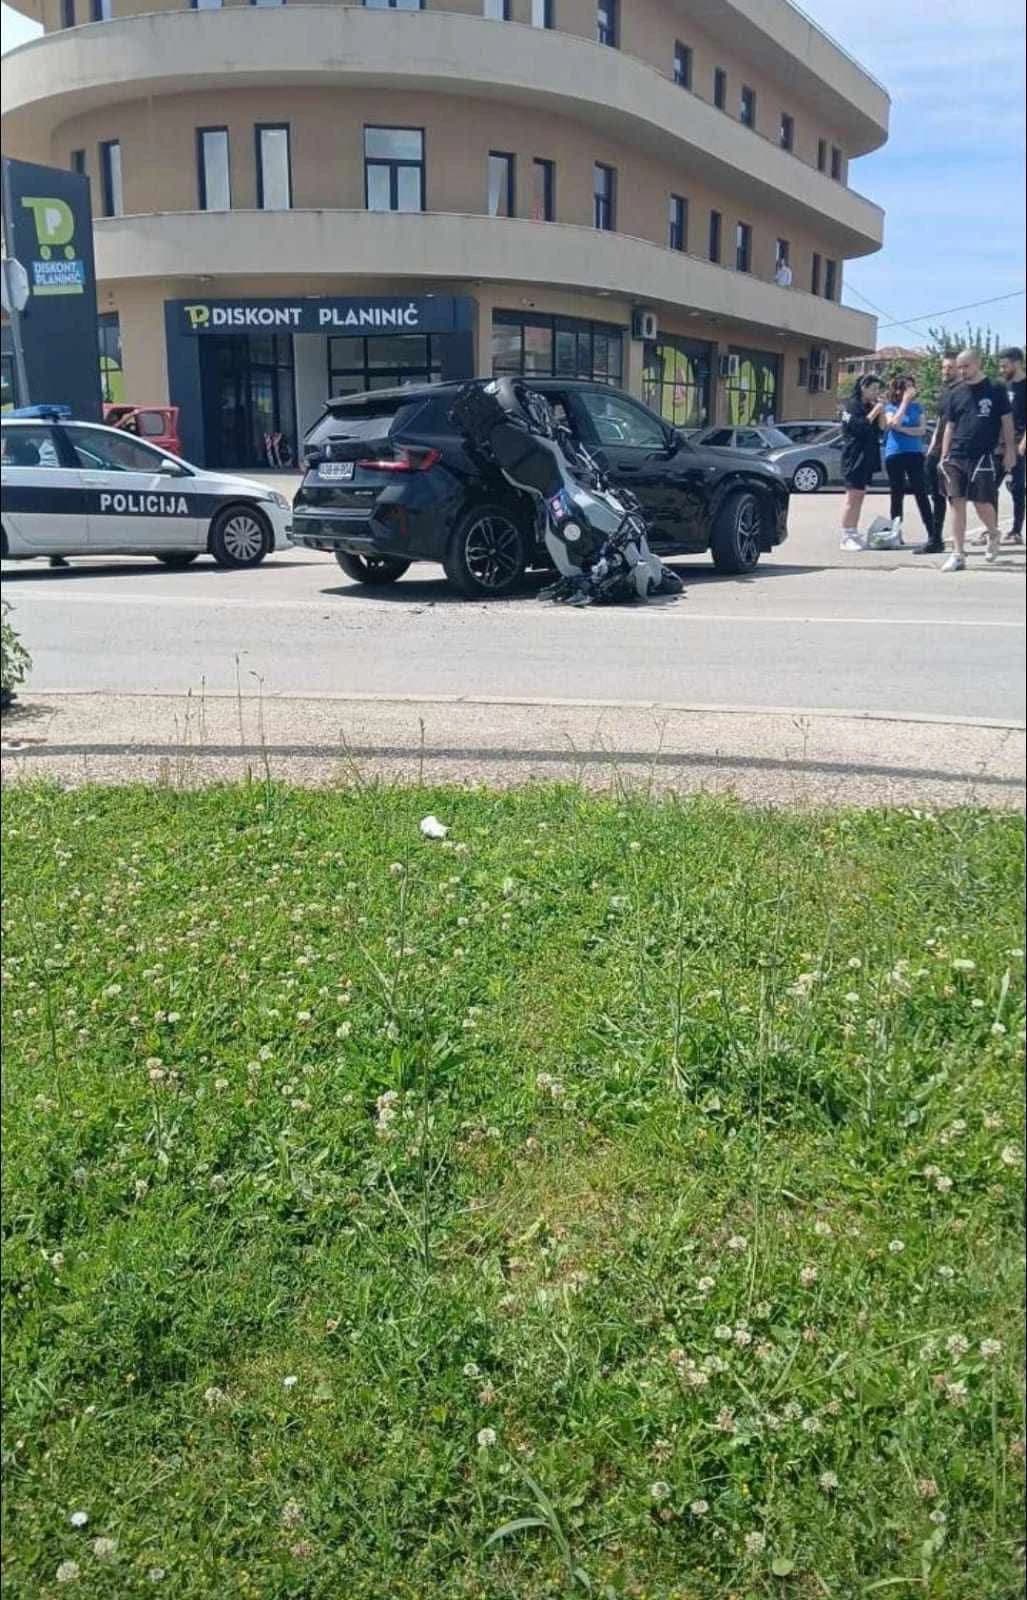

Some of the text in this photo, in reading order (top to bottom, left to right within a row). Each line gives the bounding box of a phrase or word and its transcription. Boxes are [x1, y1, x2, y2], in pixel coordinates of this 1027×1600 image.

[34, 261, 76, 273] DISKONT
[213, 307, 303, 326] DISKONT
[319, 302, 418, 326] PLANINIĆ
[99, 493, 189, 514] POLICIJA
